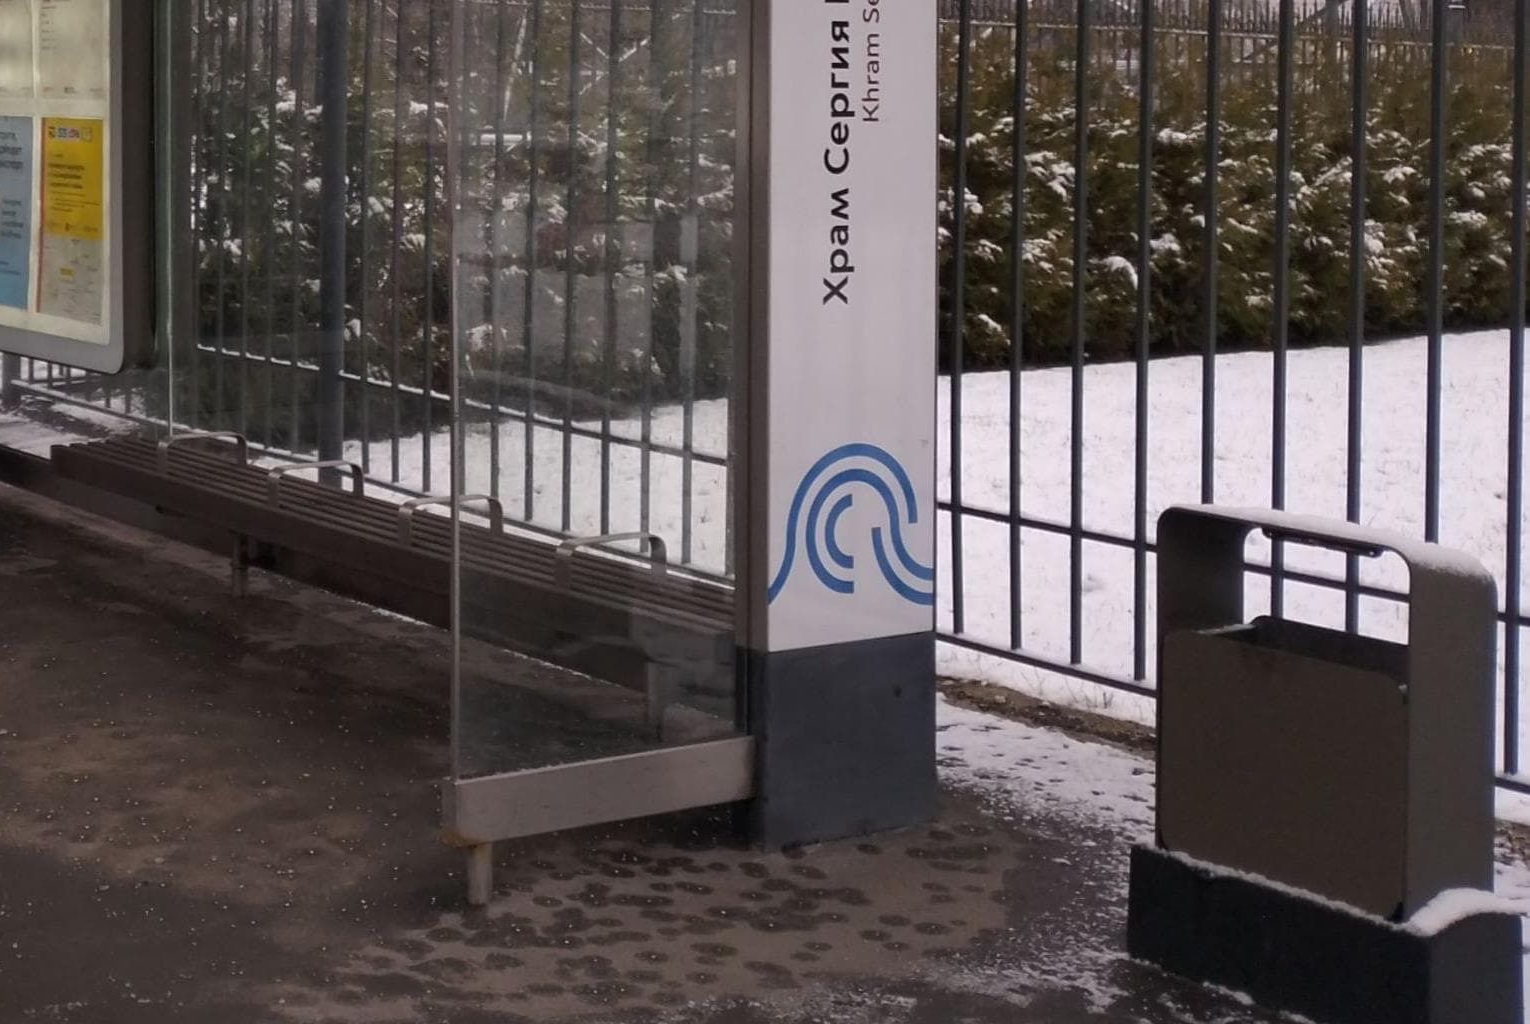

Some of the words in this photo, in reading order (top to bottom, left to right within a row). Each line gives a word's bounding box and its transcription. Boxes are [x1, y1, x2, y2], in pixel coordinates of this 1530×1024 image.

[824, 20, 855, 175] Сергия
[861, 33, 880, 122] Khram
[823, 187, 855, 305] Храм
